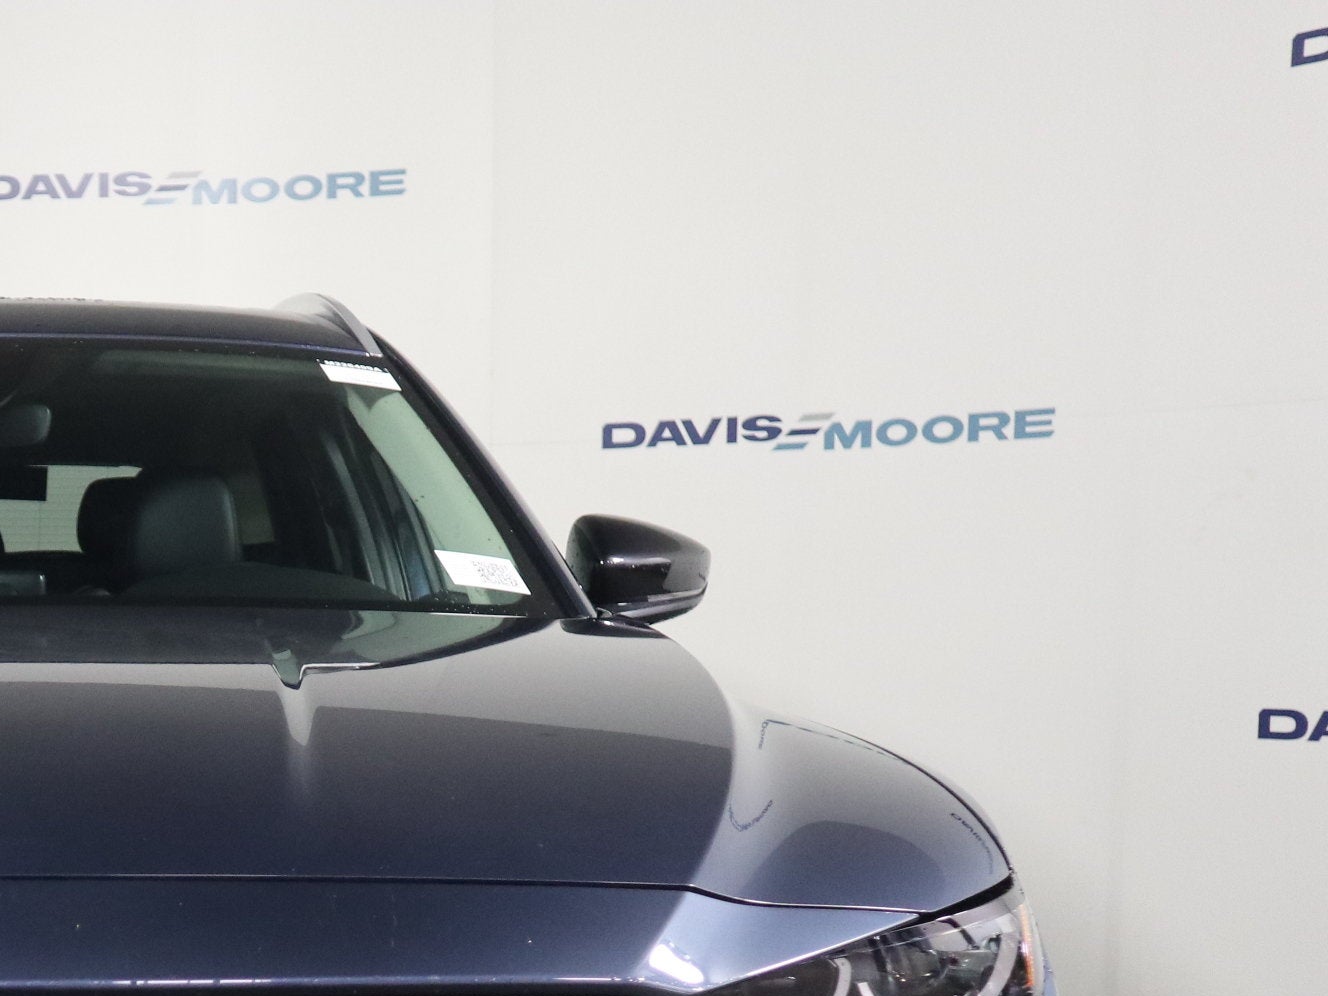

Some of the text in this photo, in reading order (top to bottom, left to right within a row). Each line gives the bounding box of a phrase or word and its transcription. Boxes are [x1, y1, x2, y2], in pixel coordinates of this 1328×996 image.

[192, 169, 407, 205] MOORE
[601, 407, 1056, 451] DAVIS MOORE
